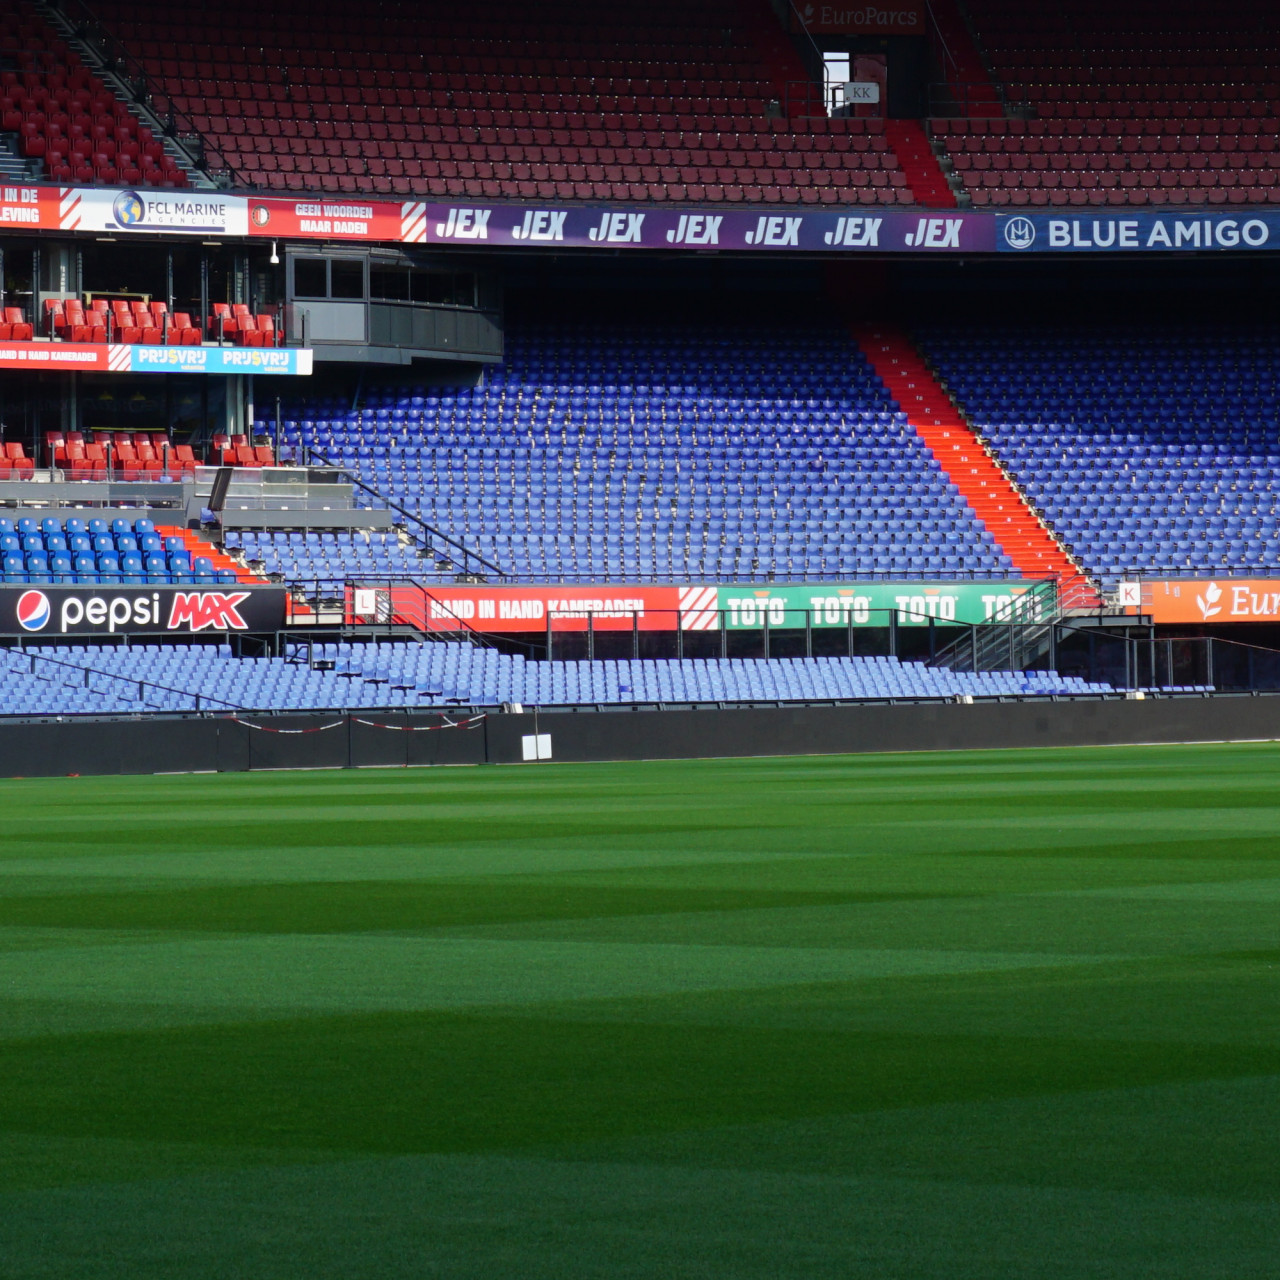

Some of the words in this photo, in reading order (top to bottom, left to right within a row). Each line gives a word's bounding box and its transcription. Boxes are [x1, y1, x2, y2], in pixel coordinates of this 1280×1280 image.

[821, 6, 917, 26] EuroParcs
[853, 88, 870, 99] KK
[4, 187, 18, 202] IN
[21, 187, 38, 203] DE
[148, 202, 171, 216] FCL
[174, 203, 226, 216] MARINE
[295, 204, 321, 218] GEEN
[324, 205, 373, 219] WOORDEN
[147, 217, 226, 225] AGENCIES
[300, 220, 330, 233] MAAR
[333, 221, 368, 235] DADEN
[436, 209, 491, 239] JEX
[512, 210, 567, 241] JEX
[589, 213, 645, 243] JEX
[667, 215, 723, 244] JEX
[745, 216, 802, 246] JEX
[824, 218, 882, 247] JEX
[905, 219, 963, 248] JEX
[1049, 221, 1138, 248] BLUE
[1148, 220, 1269, 248] AMIGO
[18, 350, 26, 360] IN
[28, 350, 49, 361] HAND
[51, 351, 97, 362] KAMERADEN
[361, 591, 371, 608] L
[1125, 587, 1135, 602] K
[61, 592, 159, 633] pepsi
[166, 591, 252, 632] MAX
[431, 600, 475, 619] HAND
[478, 600, 496, 618] IN
[499, 599, 544, 619] HAND
[548, 599, 644, 618] KAMERADEN
[728, 597, 783, 626] TOTO
[811, 596, 866, 624] TOTO
[896, 595, 952, 623] TOTO
